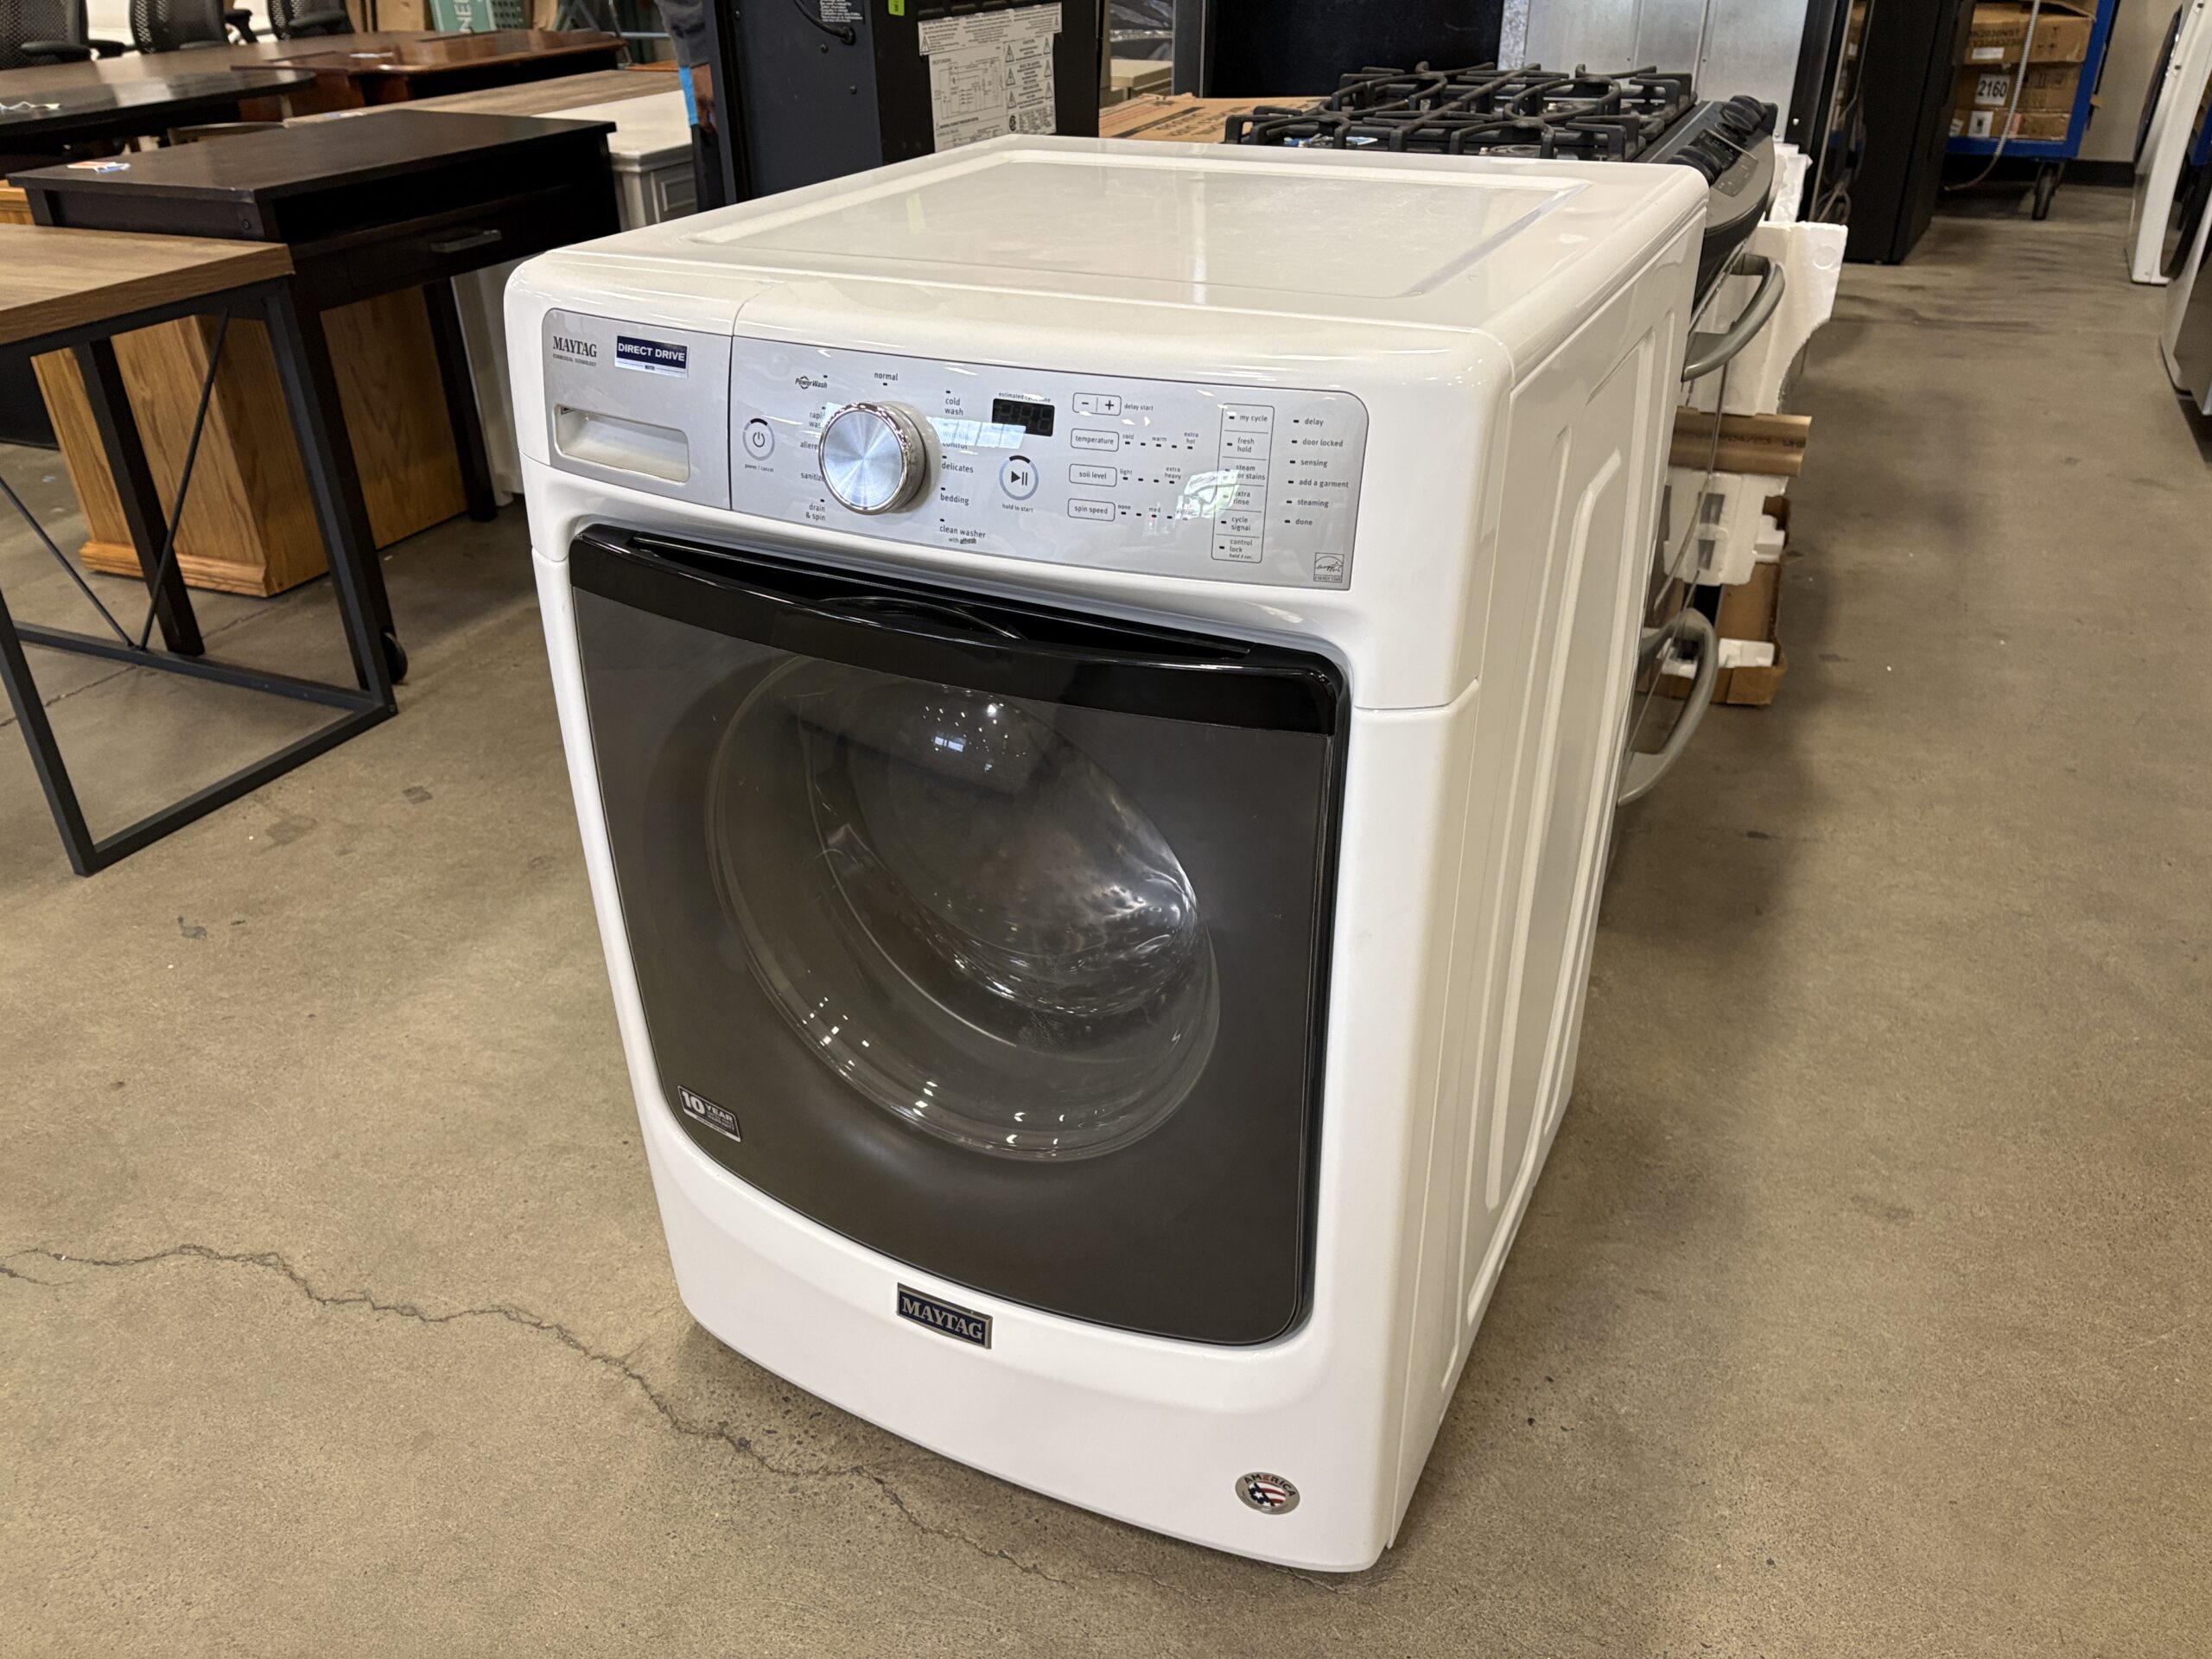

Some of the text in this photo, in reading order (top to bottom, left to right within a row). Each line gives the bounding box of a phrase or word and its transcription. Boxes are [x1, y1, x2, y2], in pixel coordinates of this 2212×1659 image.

[1977, 79, 2008, 98] 2160
[552, 335, 597, 358] MAYTAG
[618, 342, 685, 362] DIRECT DRIVE
[874, 372, 899, 381] normal
[944, 397, 961, 406] cold
[944, 407, 963, 416] wash
[1123, 403, 1140, 411] delay
[1304, 417, 1324, 427] delay
[1075, 435, 1115, 445] temperature
[1237, 436, 1255, 445] fresh
[1319, 439, 1344, 448] locked
[941, 461, 975, 474] delicates
[1300, 458, 1328, 468] sensing
[1091, 472, 1107, 480] level
[1164, 472, 1181, 480] heavy
[1245, 473, 1266, 481] stains
[1299, 478, 1313, 486] add
[1319, 480, 1350, 489] garment
[940, 493, 969, 506] bedding
[1296, 499, 1329, 508] steaming
[809, 503, 825, 512] drain
[1074, 505, 1109, 515] spin speed
[812, 512, 826, 521] spin
[1231, 516, 1249, 524] cycle
[939, 524, 986, 538] clean washer
[1230, 524, 1251, 532] signal
[1230, 538, 1253, 547] control
[681, 1090, 706, 1115] 10
[704, 1103, 734, 1123] YEAR
[901, 1296, 983, 1340] MAYTAG
[1244, 1473, 1296, 1497] AMERICA
